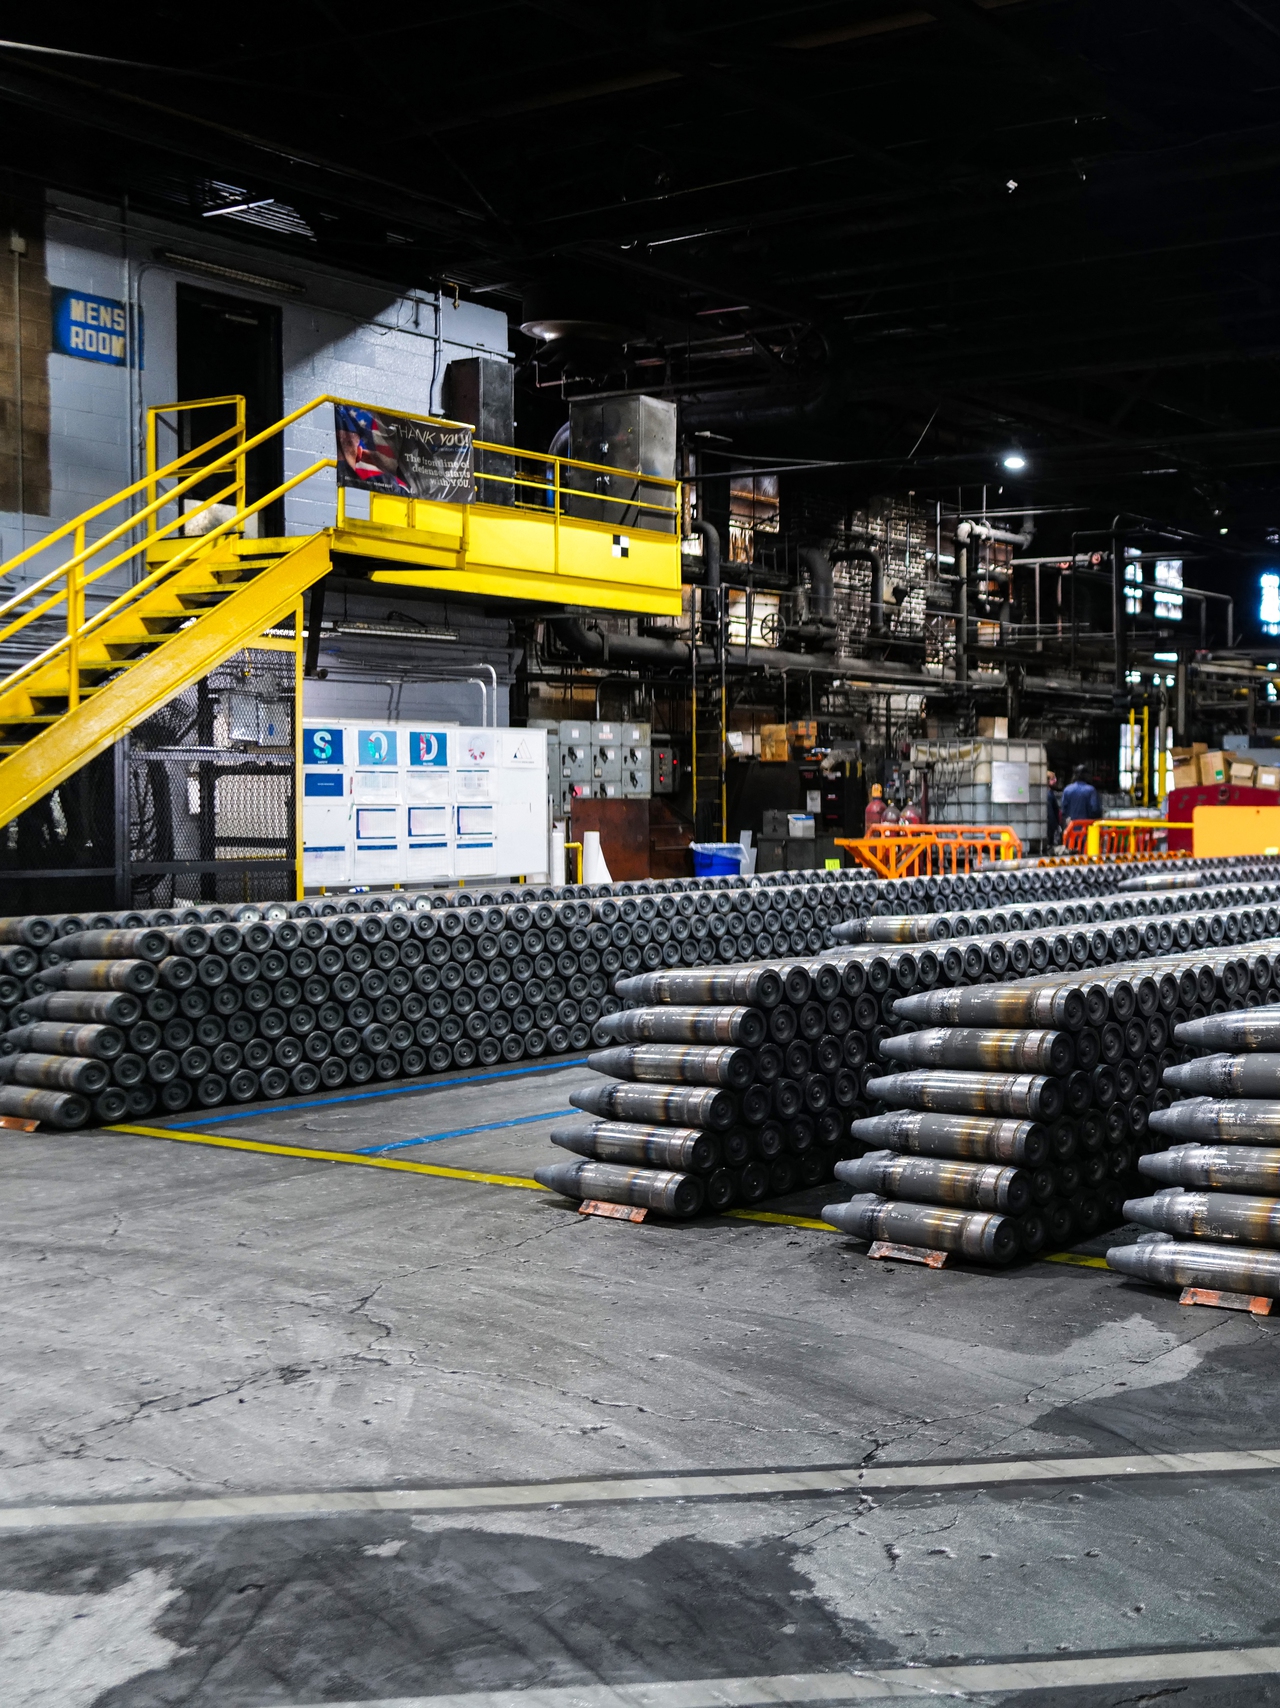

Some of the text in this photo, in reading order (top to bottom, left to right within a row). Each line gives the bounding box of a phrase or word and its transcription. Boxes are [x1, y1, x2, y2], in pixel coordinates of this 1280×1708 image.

[70, 298, 126, 331] MENS
[70, 326, 125, 358] ROOM
[391, 423, 469, 446] THANK YOU!
[404, 453, 421, 464] The
[313, 731, 332, 759] S
[420, 733, 439, 761] D
